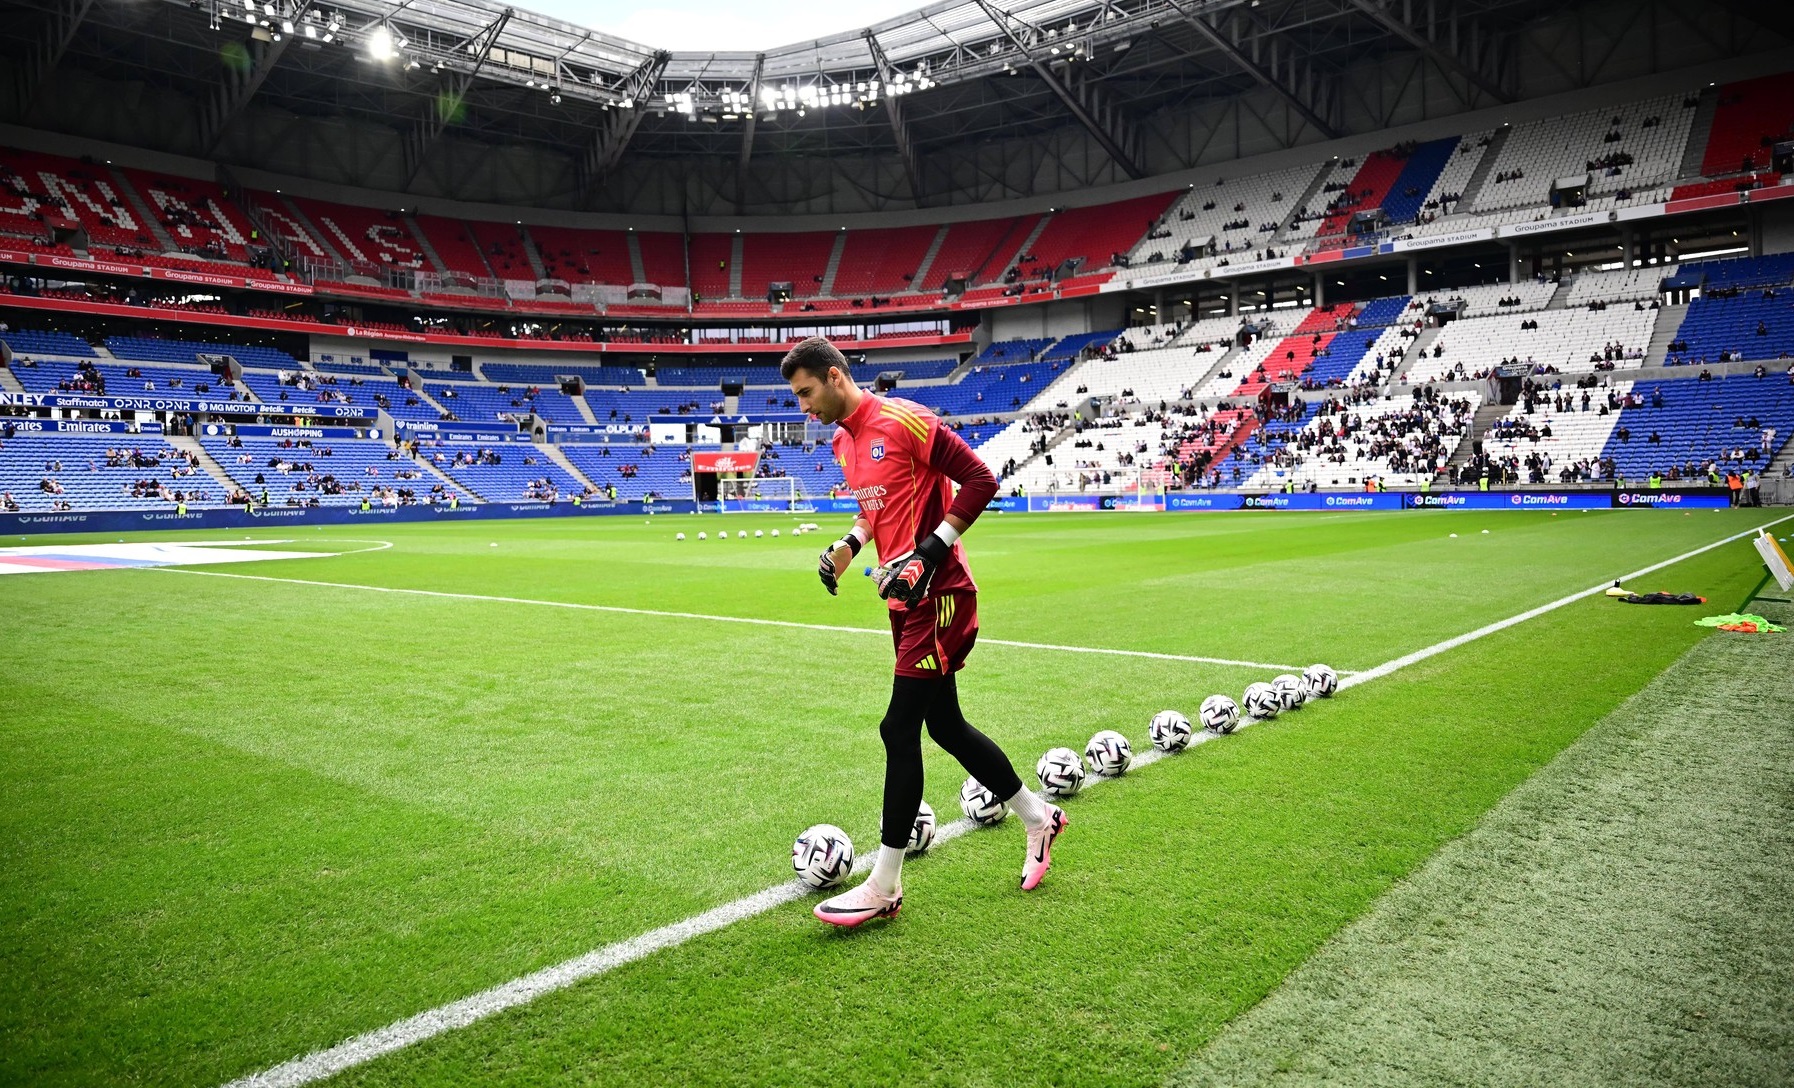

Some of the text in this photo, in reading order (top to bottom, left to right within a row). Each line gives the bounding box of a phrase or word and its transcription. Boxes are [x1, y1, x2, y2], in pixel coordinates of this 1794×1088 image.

[1515, 217, 1594, 232] Groupama STADIUM
[1406, 233, 1478, 247] Groupama STADIUM
[52, 258, 129, 273] Groupama STADIUM
[1223, 261, 1282, 274] Groupama STADIUM
[165, 271, 233, 285] Groupama STADIUM
[251, 281, 285, 290] Groupama
[56, 397, 109, 408] Staffmatch
[209, 403, 256, 412] MG MOTOR
[260, 405, 285, 413] Betclic
[292, 406, 317, 414] Betclic
[57, 421, 112, 432] Emirates
[405, 421, 439, 431] trainline
[872, 446, 883, 457] OL
[851, 484, 887, 501] mirates
[1180, 498, 1212, 507] ComAve
[1254, 497, 1289, 506] ComAve
[1335, 497, 1373, 505] ComAve
[1425, 495, 1466, 505] ComAve
[1523, 494, 1567, 505] ComAve
[1631, 493, 1681, 504] ComAve
